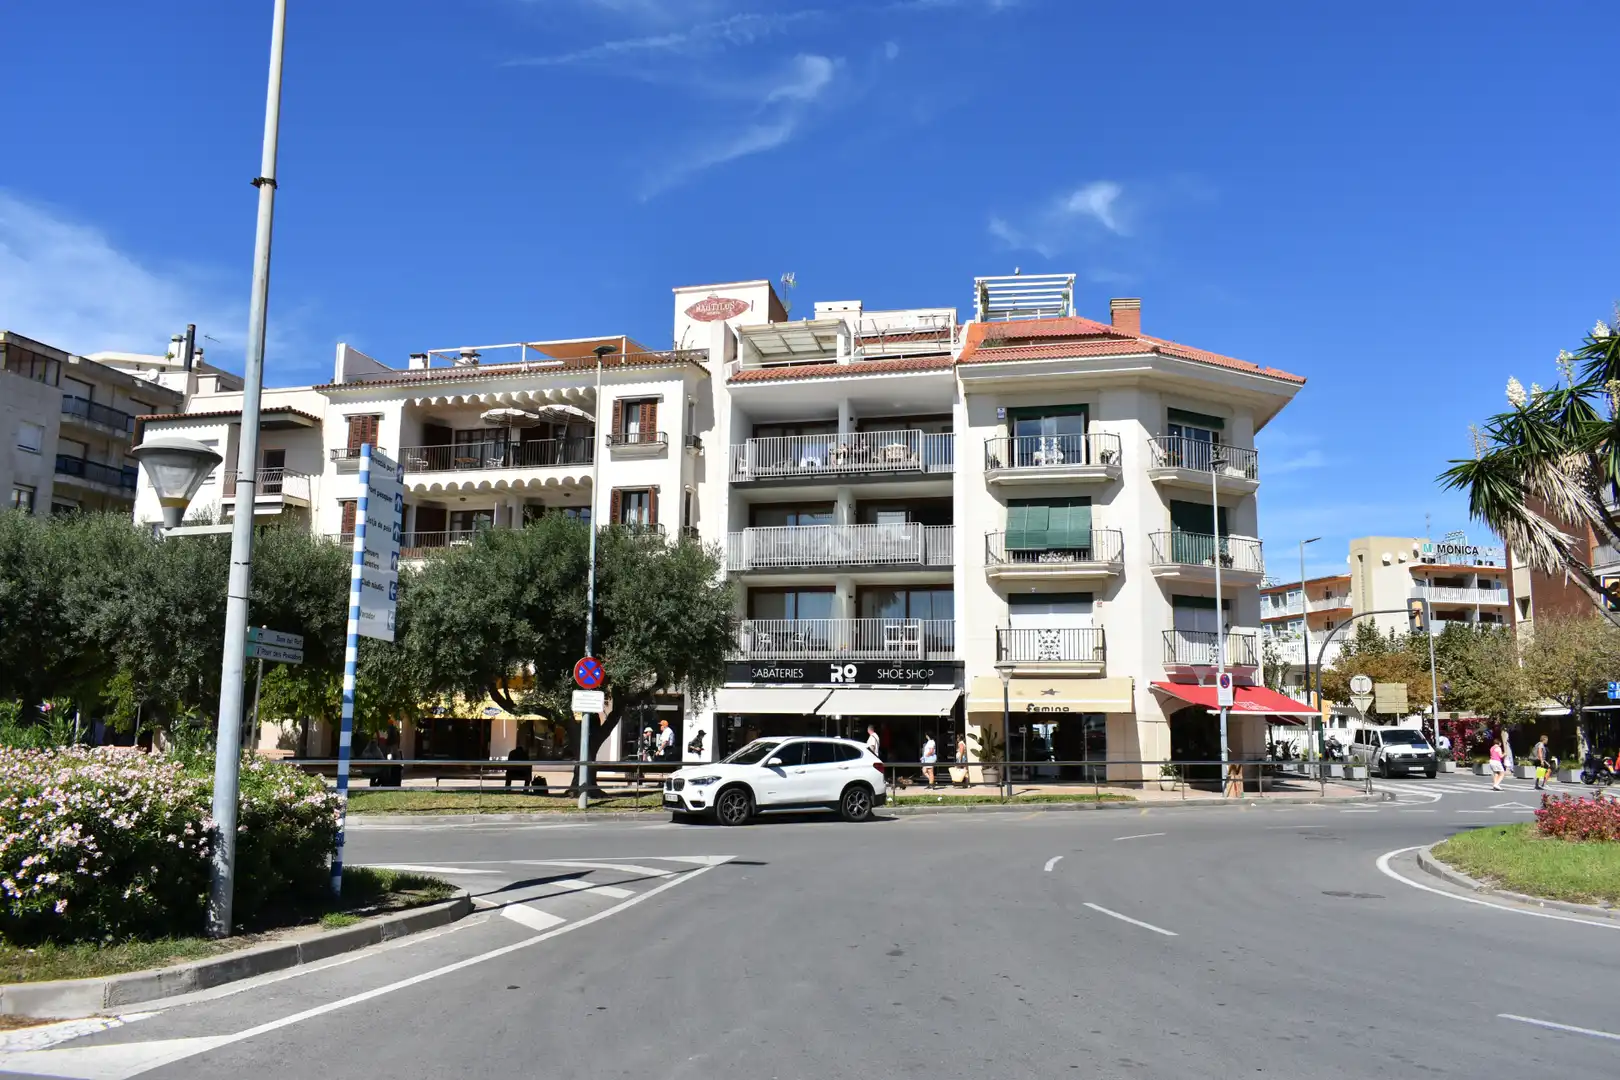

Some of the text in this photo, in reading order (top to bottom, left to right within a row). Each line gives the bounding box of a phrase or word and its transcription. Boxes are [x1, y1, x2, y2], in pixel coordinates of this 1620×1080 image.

[1437, 544, 1479, 555] MONICA
[751, 668, 804, 678] SABATERIES
[877, 668, 934, 679] SHOE SHOP
